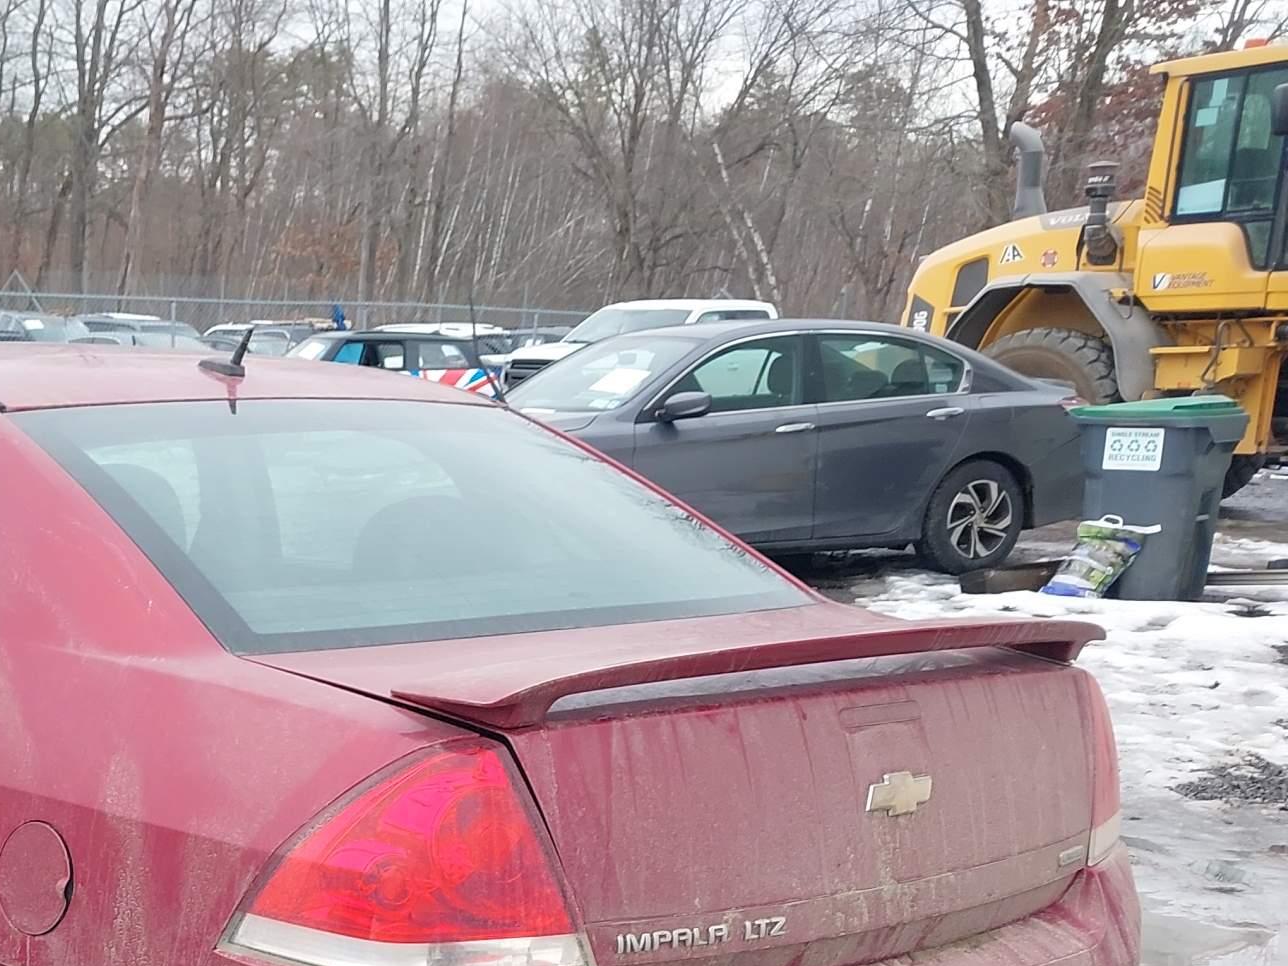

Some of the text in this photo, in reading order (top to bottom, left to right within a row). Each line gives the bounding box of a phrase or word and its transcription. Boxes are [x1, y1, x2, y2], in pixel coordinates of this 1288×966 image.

[1108, 453, 1157, 462] RECYCLING
[616, 916, 788, 954] IMPALA LTZ
